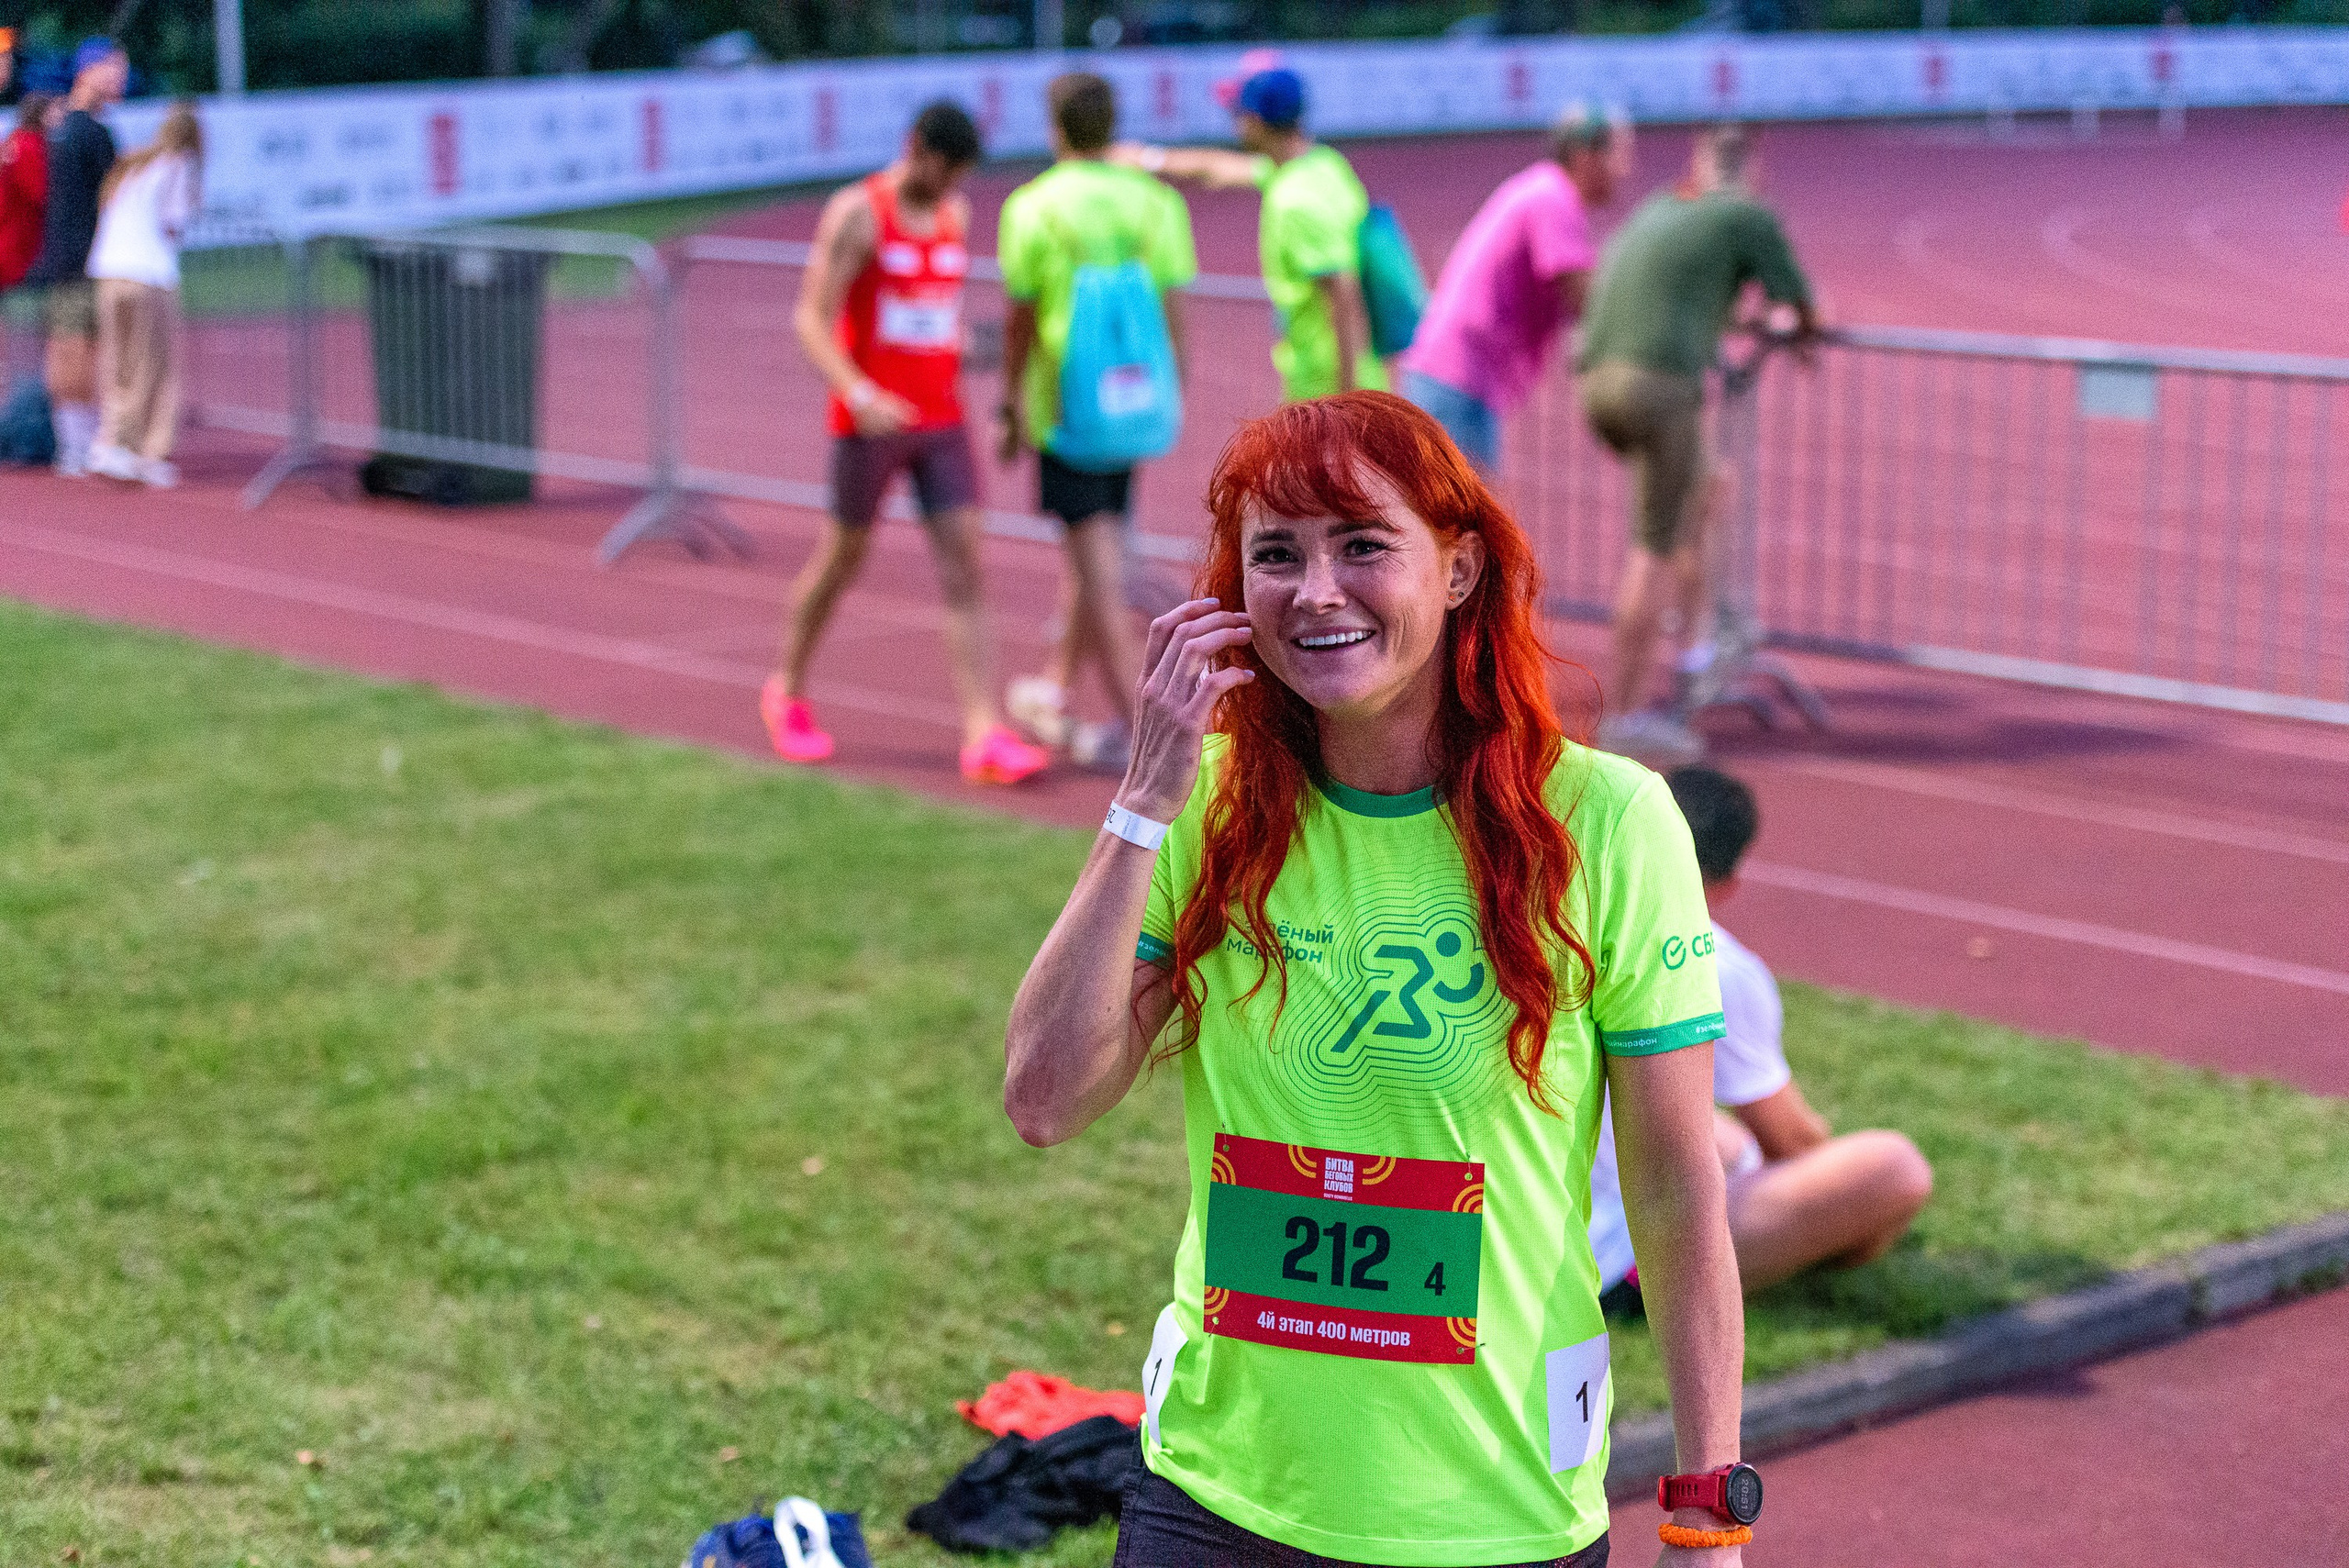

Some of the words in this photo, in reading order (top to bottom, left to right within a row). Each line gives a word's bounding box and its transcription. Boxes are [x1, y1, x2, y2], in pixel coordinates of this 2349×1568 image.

[1692, 931, 1715, 958] СБ
[1324, 1171, 1354, 1182] БЕГОВЫХ
[1325, 1157, 1354, 1173] БИТВА
[1323, 1180, 1353, 1194] КЛУБОВ
[1282, 1216, 1390, 1292] 212
[1424, 1262, 1446, 1296] 4
[1257, 1311, 1275, 1330] 4й
[1279, 1317, 1313, 1336] этап
[1317, 1320, 1346, 1340] 400
[1350, 1326, 1411, 1348] метров
[1150, 1358, 1163, 1396] 1
[1575, 1381, 1589, 1422] 1
